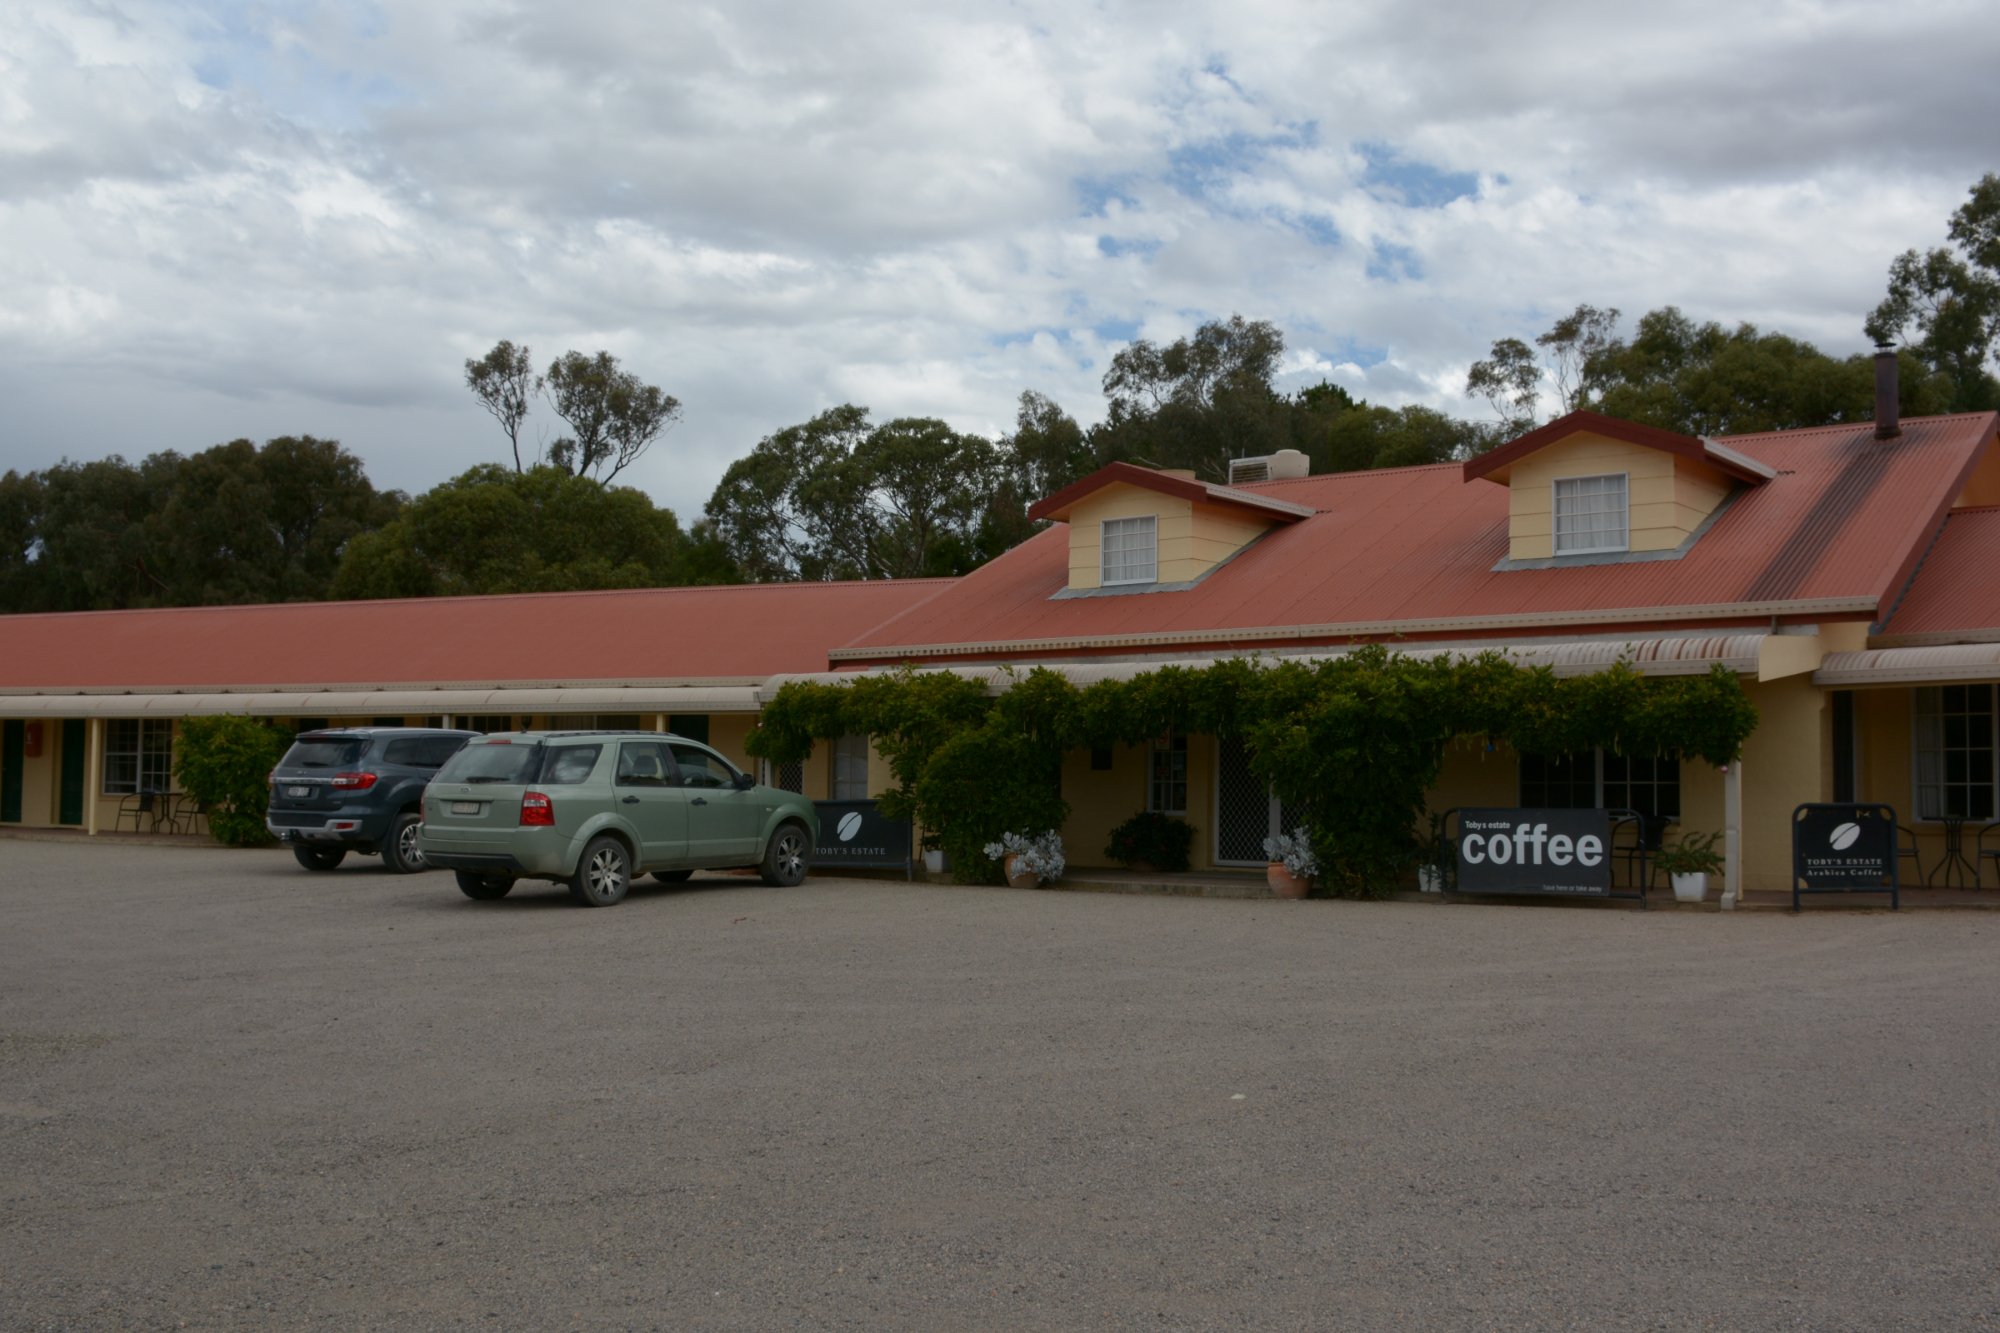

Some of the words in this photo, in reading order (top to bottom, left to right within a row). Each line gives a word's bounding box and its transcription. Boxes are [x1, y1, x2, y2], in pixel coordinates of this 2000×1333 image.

[1465, 821, 1487, 830] Tobys
[1488, 821, 1511, 829] estate
[1462, 823, 1604, 867] coffee
[816, 847, 848, 855] TOBY'S
[851, 847, 886, 855] ESTATE
